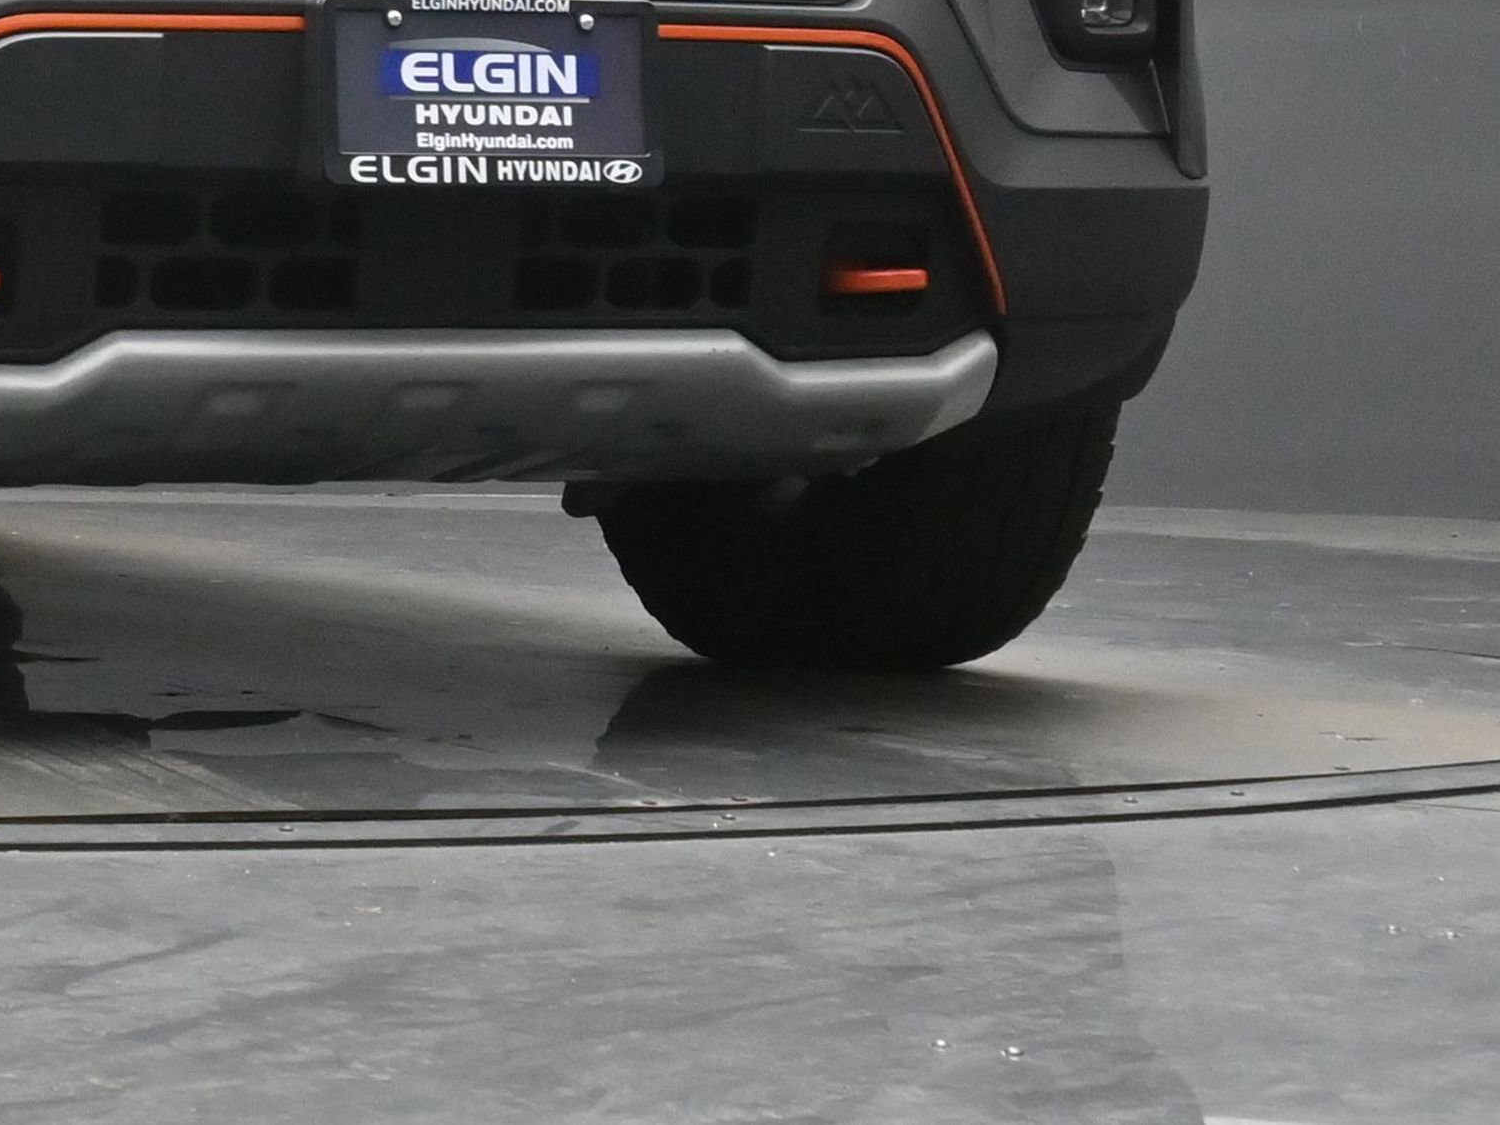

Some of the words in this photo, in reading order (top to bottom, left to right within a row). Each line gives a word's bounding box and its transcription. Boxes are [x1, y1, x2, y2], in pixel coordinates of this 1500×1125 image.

[400, 52, 578, 94] ELGIN
[415, 104, 572, 126] HYUNDAI
[416, 132, 573, 150] ElginHyundai.com
[350, 155, 488, 183] ELGIN
[497, 160, 601, 181] HYUNDAI
